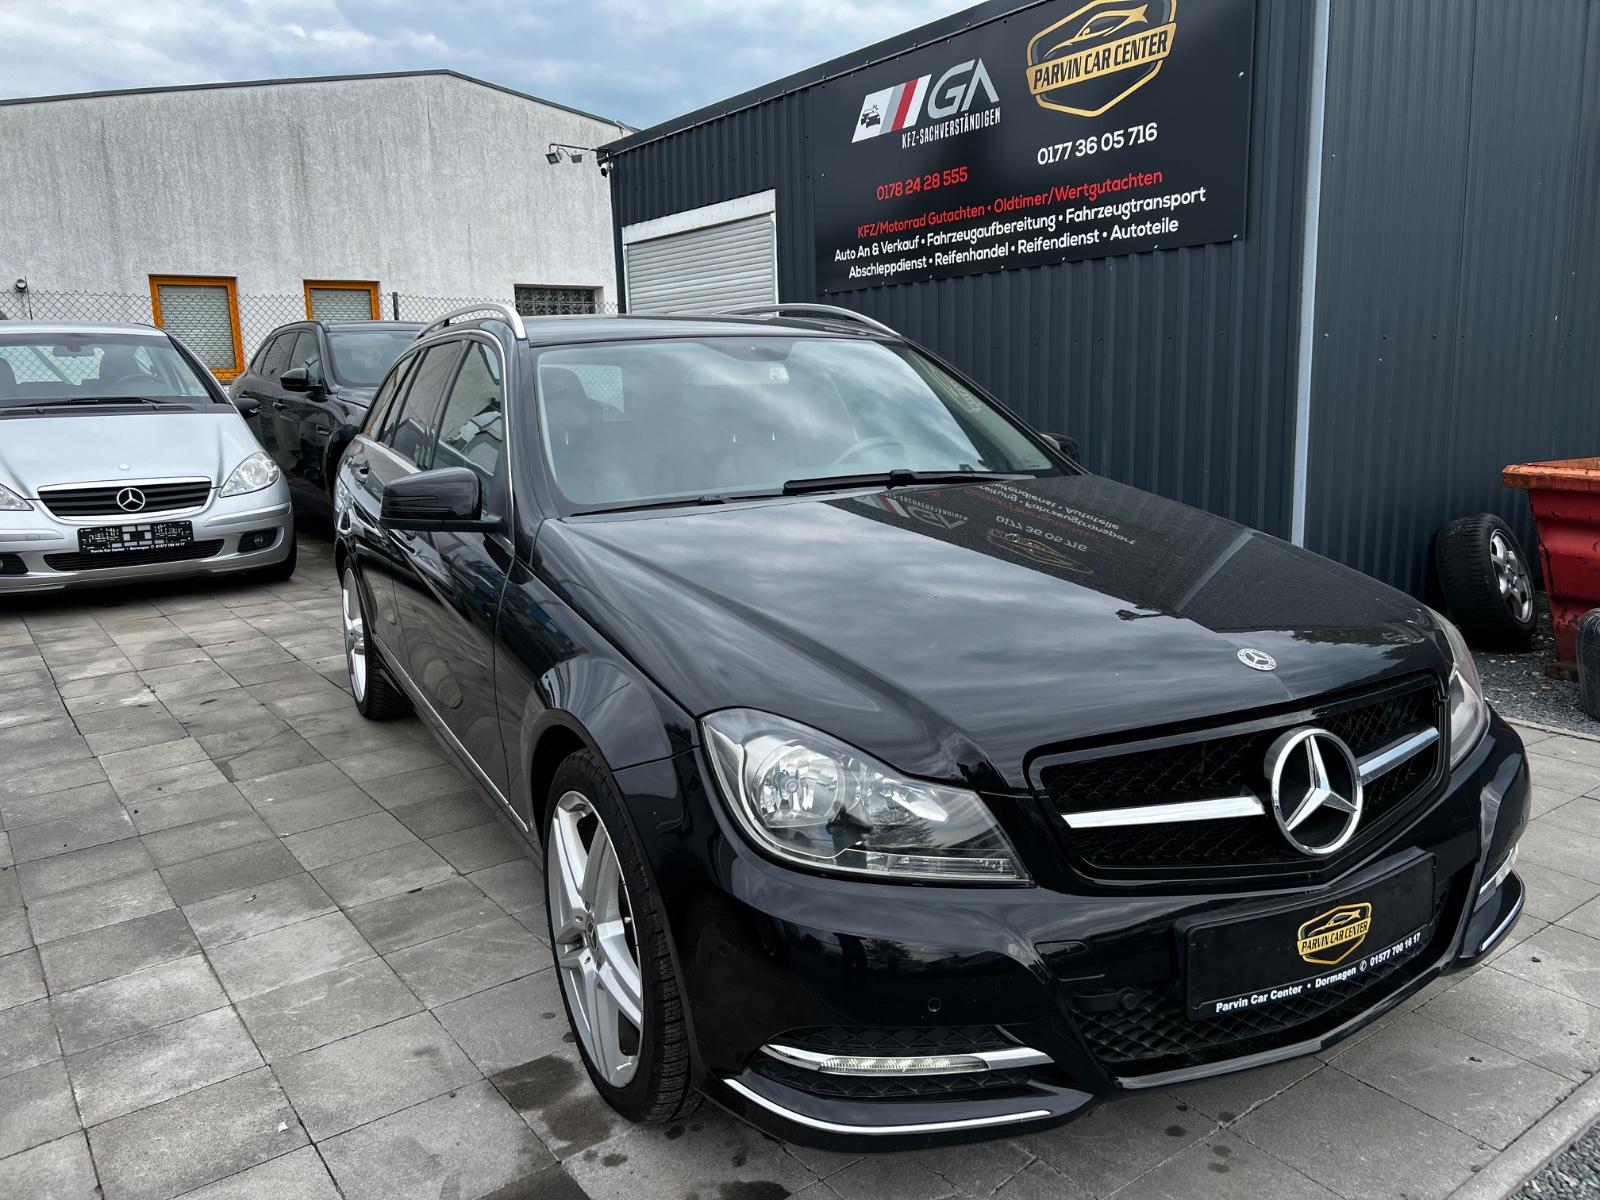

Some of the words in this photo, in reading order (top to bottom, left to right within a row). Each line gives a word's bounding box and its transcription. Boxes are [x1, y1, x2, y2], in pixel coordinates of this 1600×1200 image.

[1033, 59, 1082, 90] PARVIN
[1083, 50, 1114, 75] CAR
[1114, 29, 1168, 65] CENTER
[901, 106, 1001, 149] KFZ-SACHVERSTÄNDIGEN
[1037, 141, 1073, 165] 0177
[1075, 136, 1098, 157] 36
[1101, 130, 1125, 151] 05
[1127, 122, 1158, 146] 716
[857, 213, 927, 239] KFZ/Motorrad
[928, 204, 985, 225] Gutachten
[993, 170, 1164, 213] Oldtimer/Wertgutachten
[876, 181, 903, 201] 0178
[905, 176, 921, 195] 24
[923, 172, 941, 191] 28
[943, 165, 969, 187] 555
[834, 249, 856, 262] Auto
[857, 245, 871, 259] An
[872, 243, 880, 256] &
[880, 235, 921, 255] Verkauf
[926, 214, 1056, 247] Fahrzeugaufbereitung
[1065, 187, 1207, 223] Fahrzeugtransport
[848, 255, 927, 279] Abschleppdienst
[934, 242, 1009, 266] Reifenhandel
[1017, 228, 1100, 254] Reifendienst
[1110, 217, 1179, 241] Autoteile
[1301, 935, 1329, 952] PARVIN
[1329, 930, 1344, 946] CAR
[1344, 920, 1369, 942] CENTER
[1215, 998, 1249, 1013] Parvin
[1250, 992, 1268, 1005] Car
[1270, 984, 1303, 1000] Center
[1315, 966, 1357, 989] Dormagen
[1369, 950, 1392, 967] 01577
[1392, 943, 1404, 958] 700
[1413, 931, 1421, 945] 17
